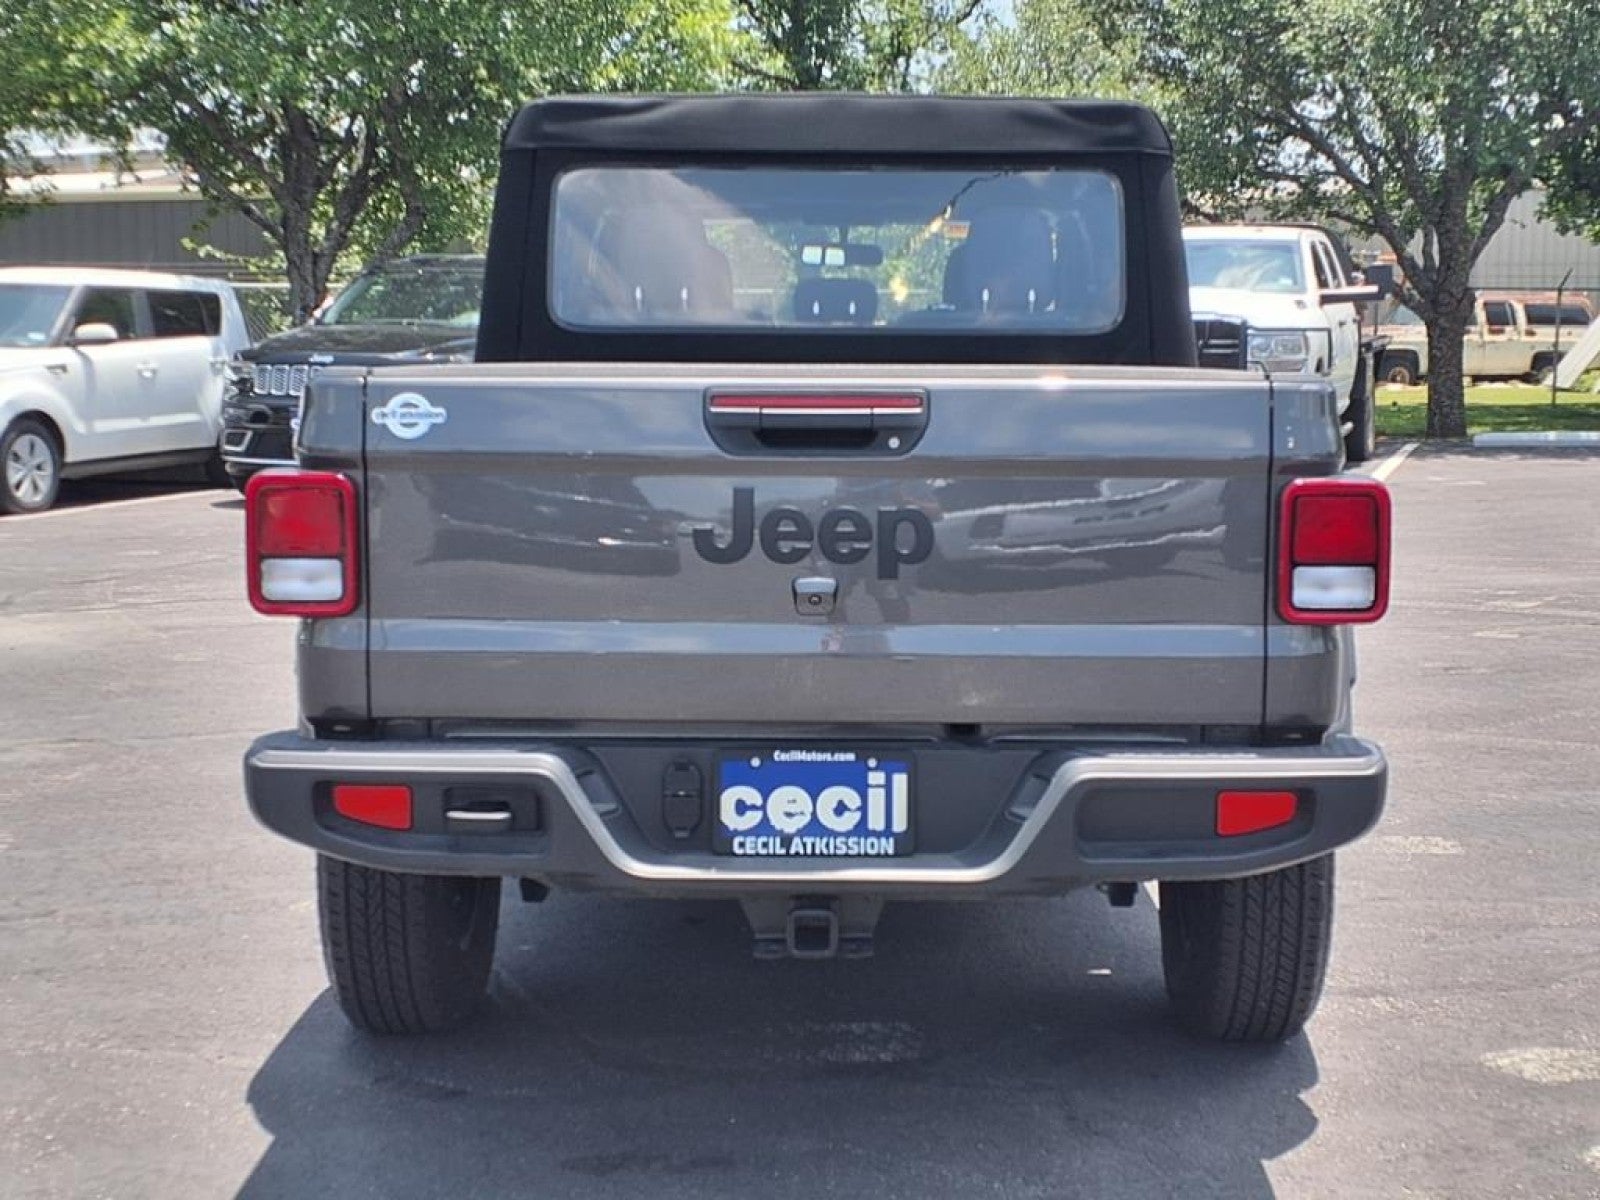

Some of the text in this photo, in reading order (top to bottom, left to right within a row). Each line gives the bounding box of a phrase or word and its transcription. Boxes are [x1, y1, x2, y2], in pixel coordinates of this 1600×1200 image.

[692, 487, 935, 580] Jeep
[773, 750, 856, 762] CecilMotors.com
[719, 771, 908, 833] cecil
[732, 837, 895, 855] CECIL ATKISSION
